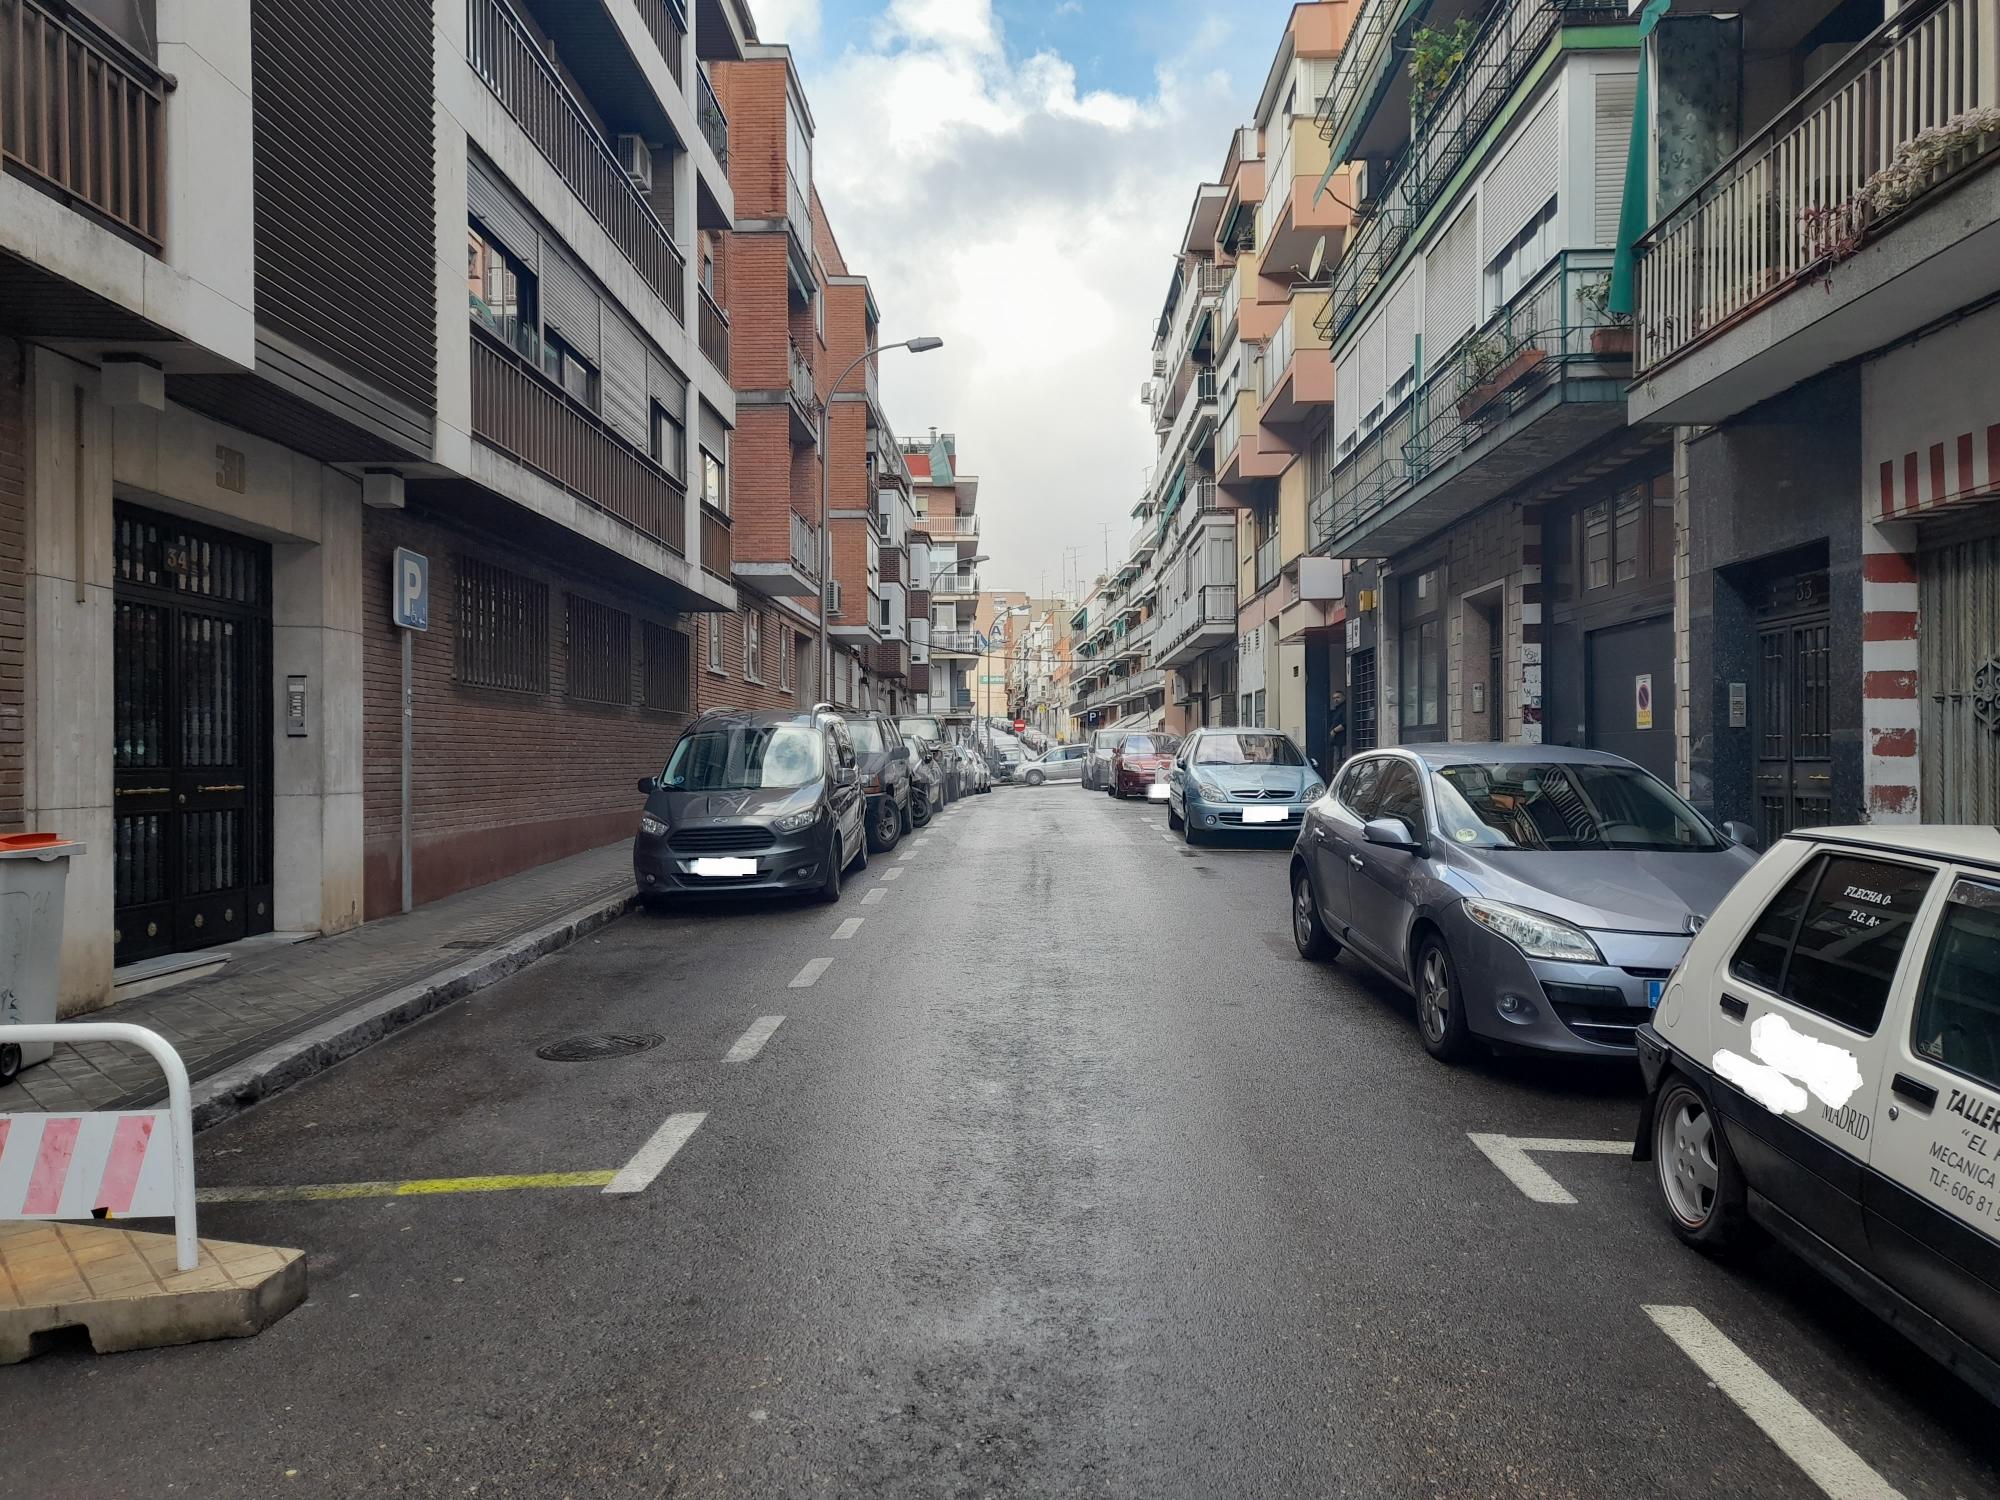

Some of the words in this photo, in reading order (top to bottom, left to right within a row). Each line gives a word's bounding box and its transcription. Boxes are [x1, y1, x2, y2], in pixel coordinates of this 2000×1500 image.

[167, 547, 188, 571] 34
[404, 559, 422, 616] P
[1089, 712, 1097, 722] P
[1844, 886, 1883, 903] FLECHA
[1848, 909, 1866, 924] P.G.
[1866, 916, 1880, 927] A+
[1821, 1103, 1870, 1141] MADRID
[1929, 1141, 1996, 1188] MECANICA
[1929, 1167, 1950, 1192] TLF:
[1951, 1181, 1976, 1206] 606
[1976, 1196, 1993, 1217] 81
